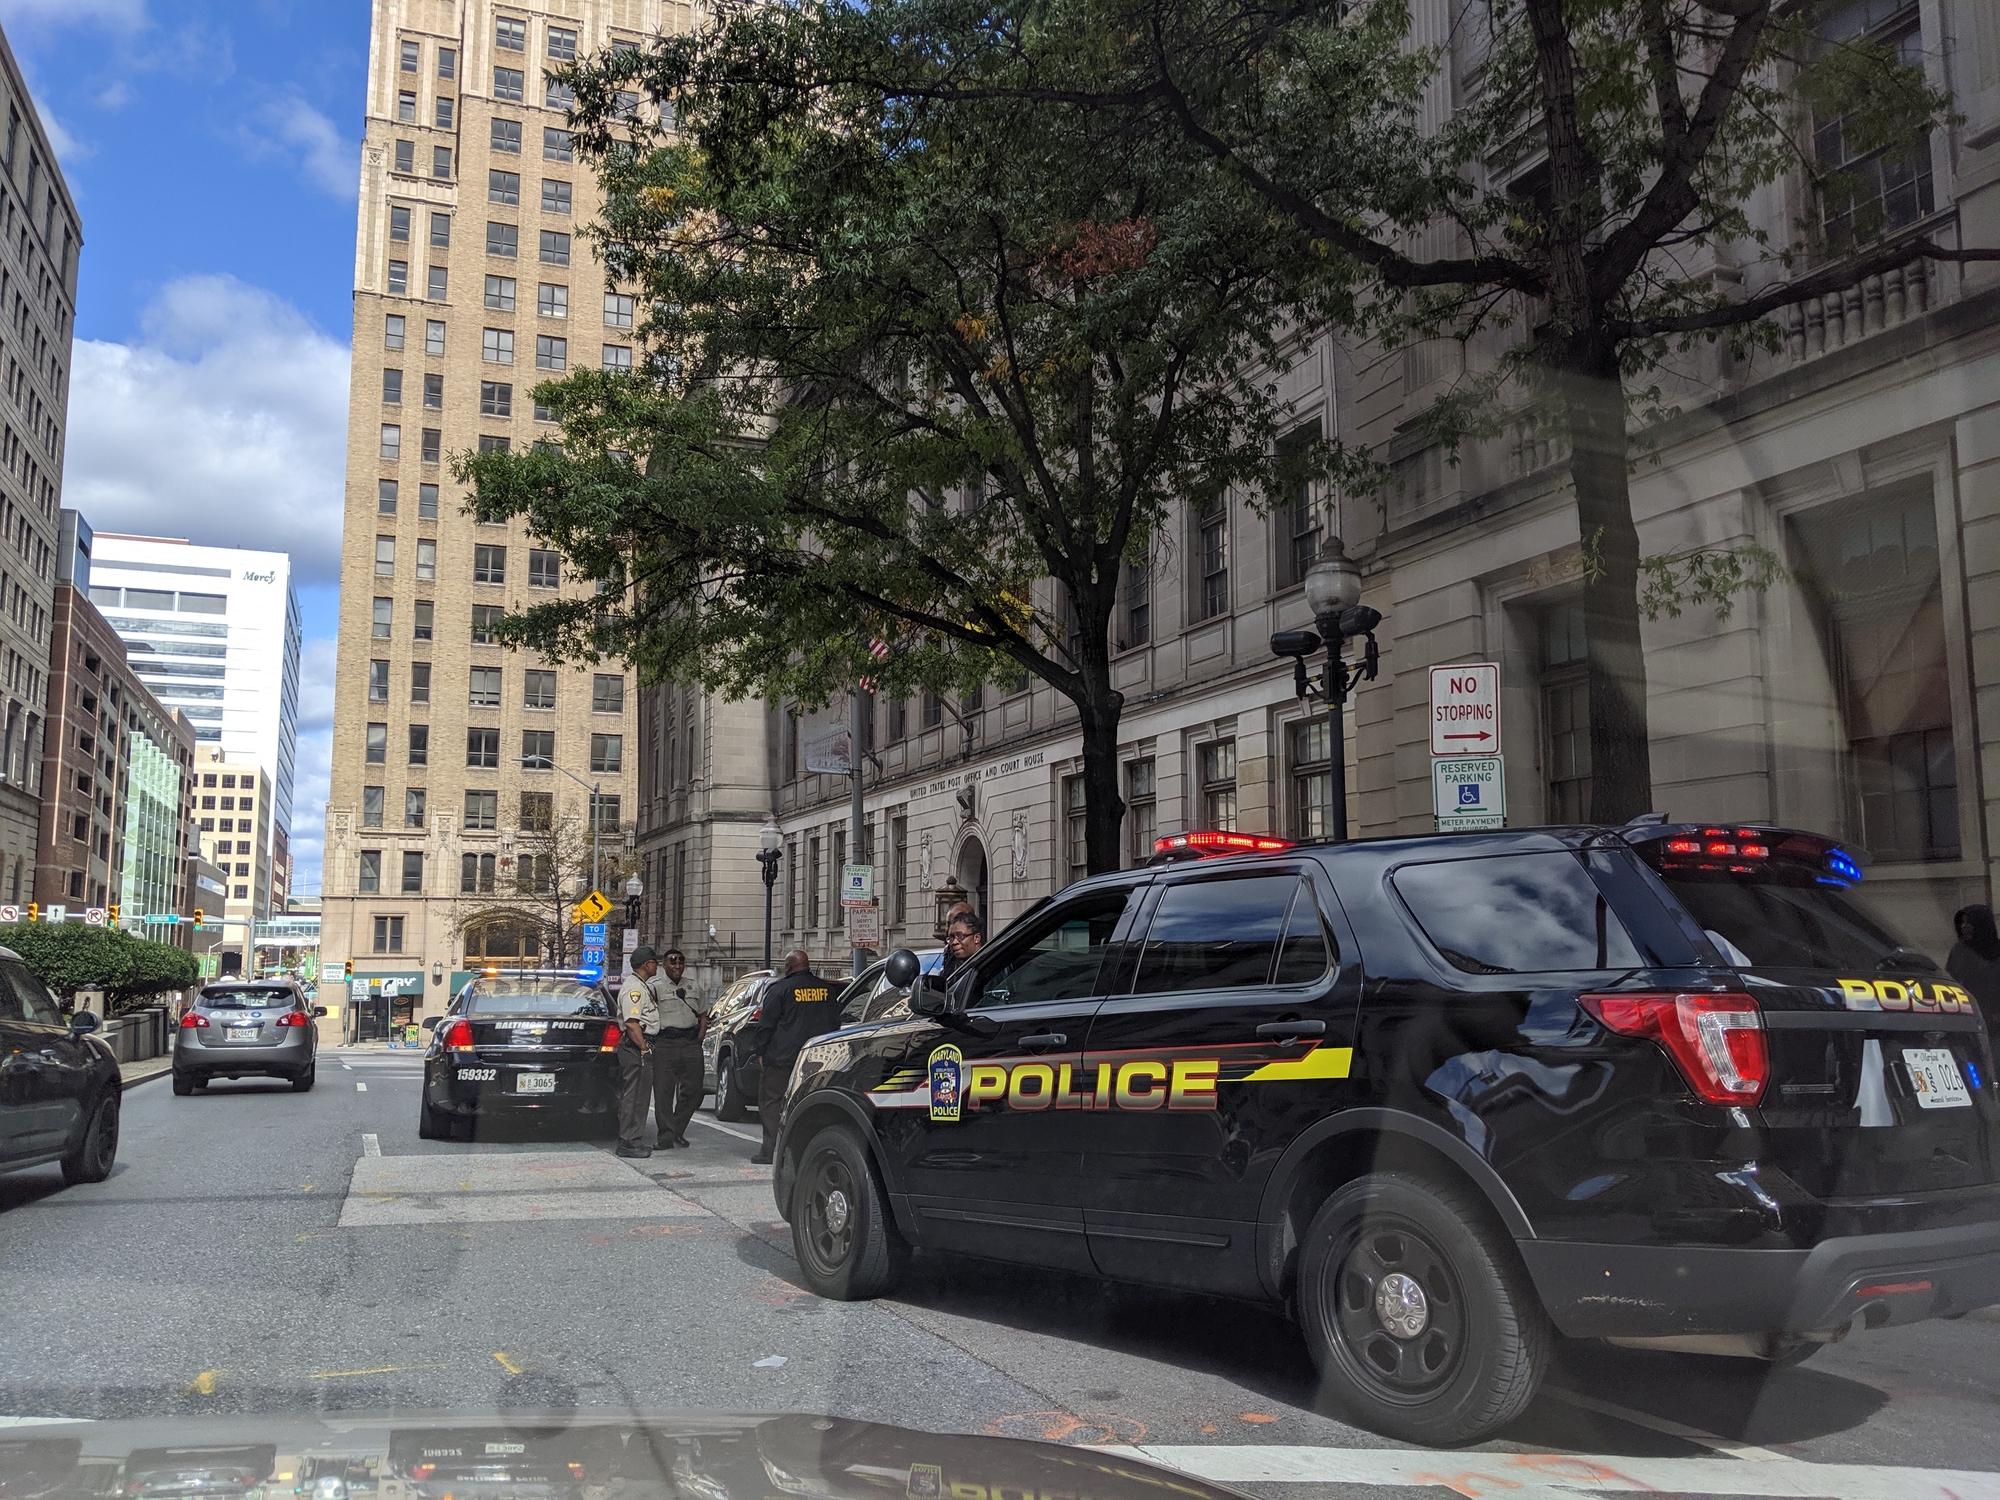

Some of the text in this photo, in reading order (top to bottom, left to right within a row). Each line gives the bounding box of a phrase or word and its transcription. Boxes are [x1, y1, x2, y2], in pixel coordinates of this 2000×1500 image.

[243, 571, 275, 584] Mercy
[1451, 677, 1477, 694] NO
[1436, 704, 1493, 721] STOPPING
[1441, 762, 1495, 774] RESERVED
[910, 752, 1044, 799] UNITED STATES POST OFFICE AND COURT HOUSE
[1445, 773, 1492, 784] PARKING
[1441, 817, 1500, 827] METER PAYMENT
[588, 951, 599, 963] 83
[794, 988, 828, 1001] SHERIFF
[495, 1021, 585, 1030] BALTIMORE POLICE
[931, 1049, 960, 1064] MARYLAND
[457, 1069, 497, 1081] 159332
[534, 1078, 553, 1088] 3065
[967, 1057, 1220, 1111] POLICE
[933, 1106, 958, 1116] POLICE
